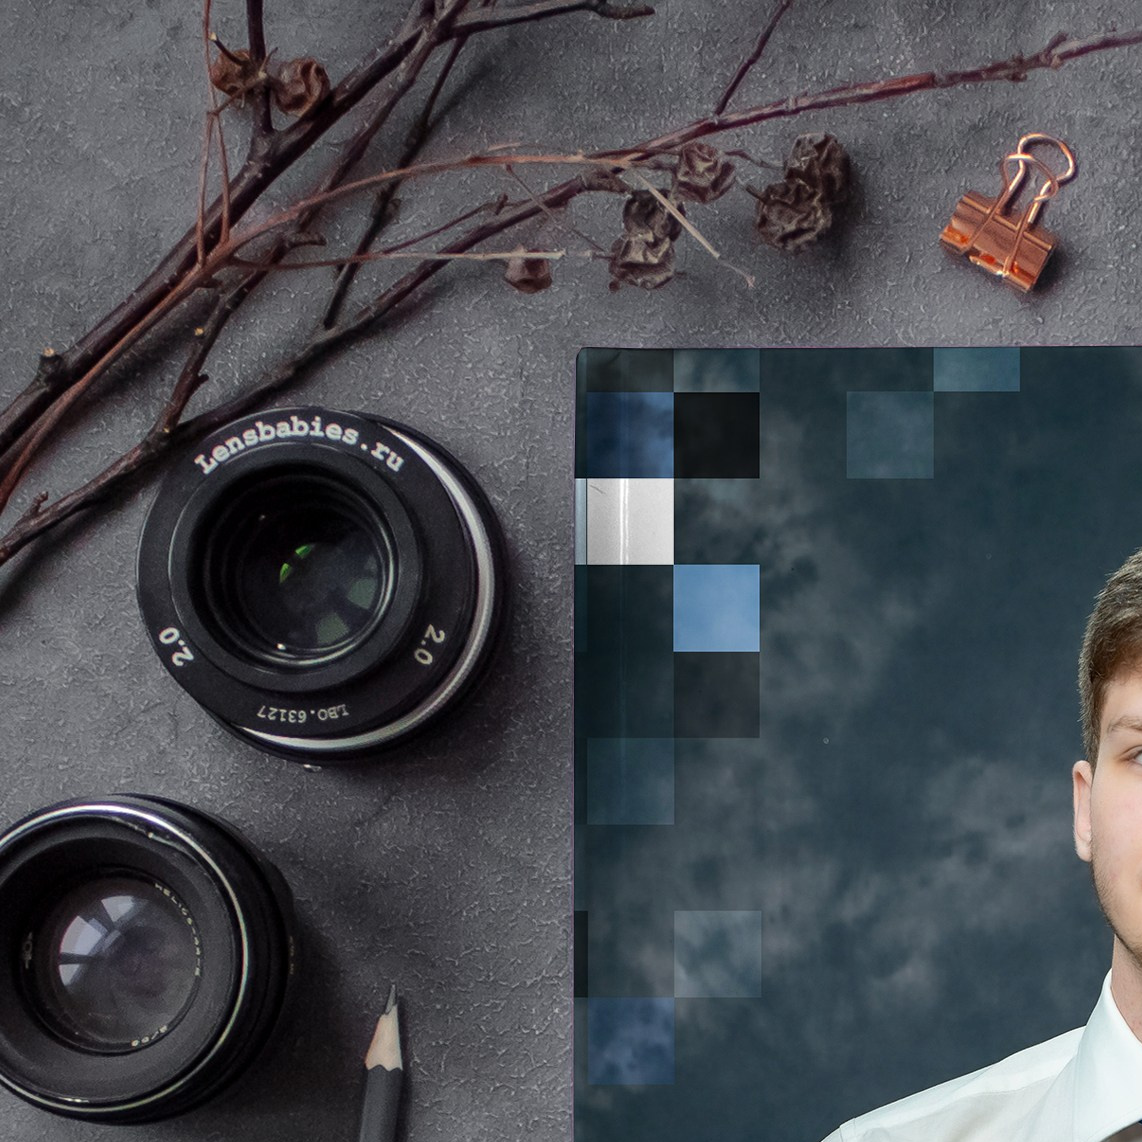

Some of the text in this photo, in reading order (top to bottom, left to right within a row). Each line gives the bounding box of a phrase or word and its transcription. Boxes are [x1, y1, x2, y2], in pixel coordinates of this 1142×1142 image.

[194, 416, 405, 474] Lensbabies.ru
[158, 626, 195, 667] 2.0
[414, 624, 446, 666] 2.0
